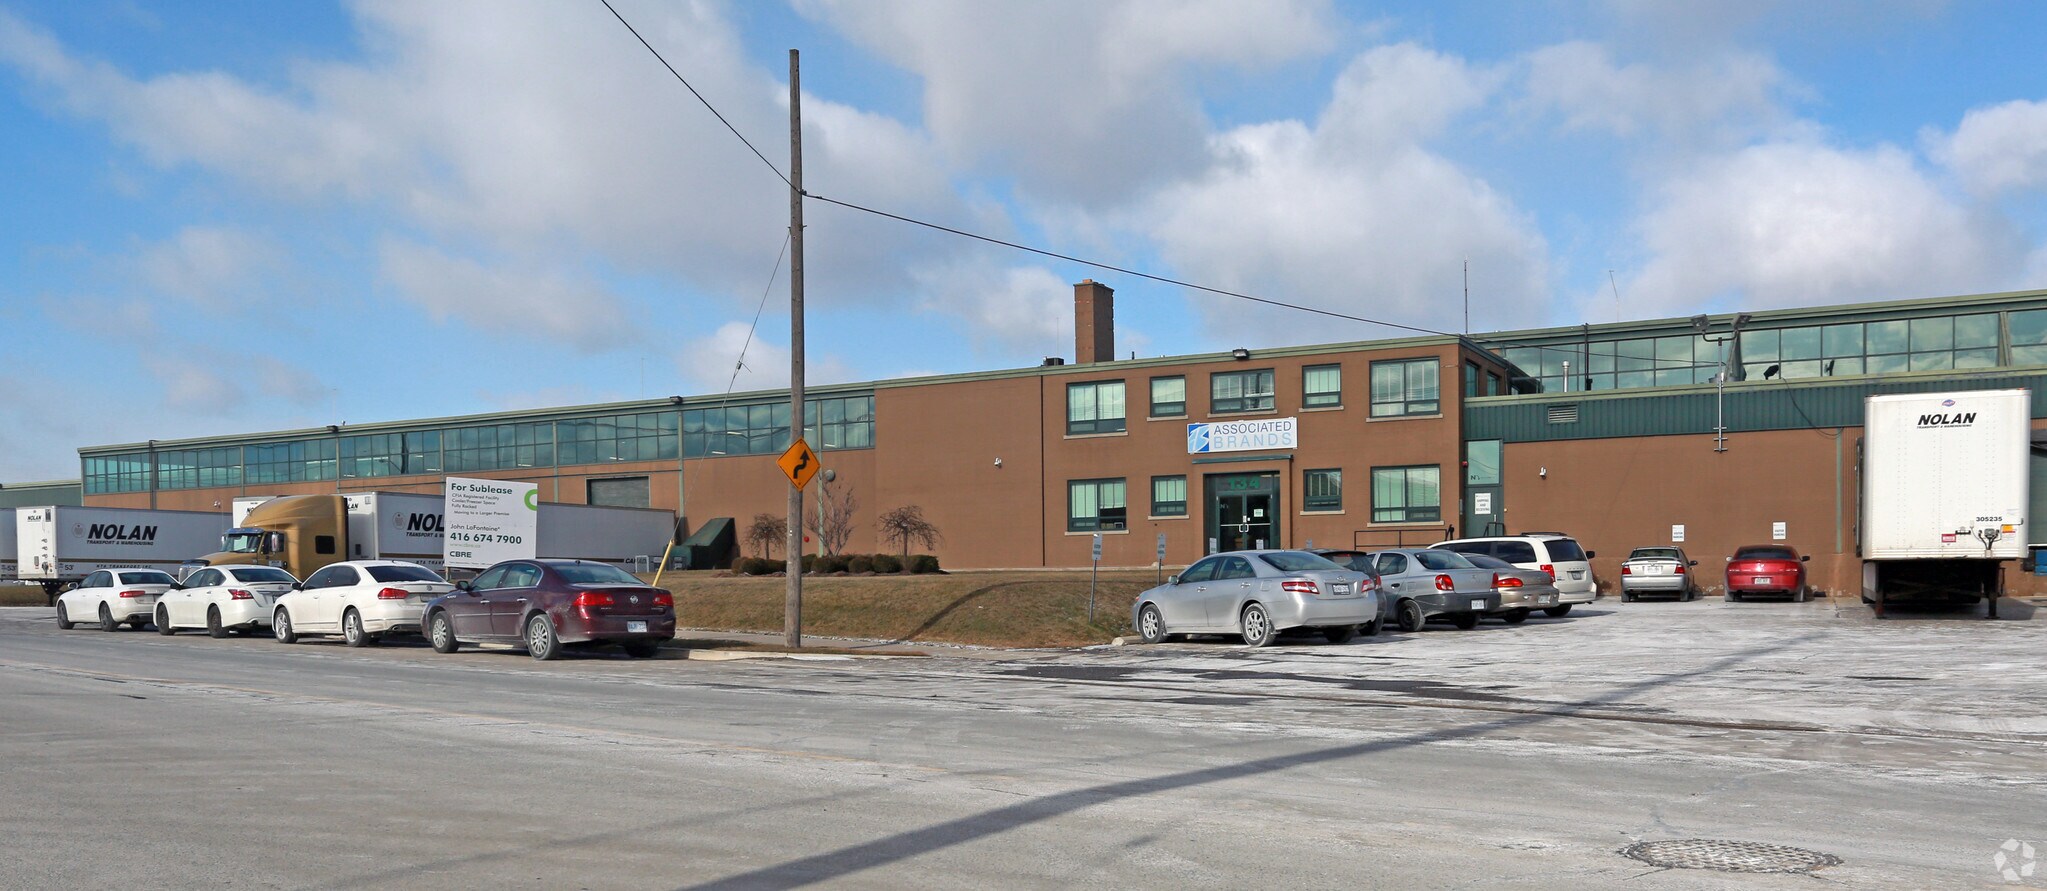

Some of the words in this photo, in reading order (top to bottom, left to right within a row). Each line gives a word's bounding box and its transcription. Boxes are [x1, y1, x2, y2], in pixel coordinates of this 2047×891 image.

[1917, 412, 1977, 425] NOLAN
[1213, 421, 1292, 435] ASSOCIATED
[1213, 432, 1292, 449] BRANDS
[451, 483, 467, 491] For
[469, 484, 513, 494] Sublease
[407, 512, 444, 532] NOL
[88, 523, 158, 540] NOLAN
[450, 532, 470, 541] 416
[473, 533, 493, 543] 674
[496, 535, 522, 544] 7900
